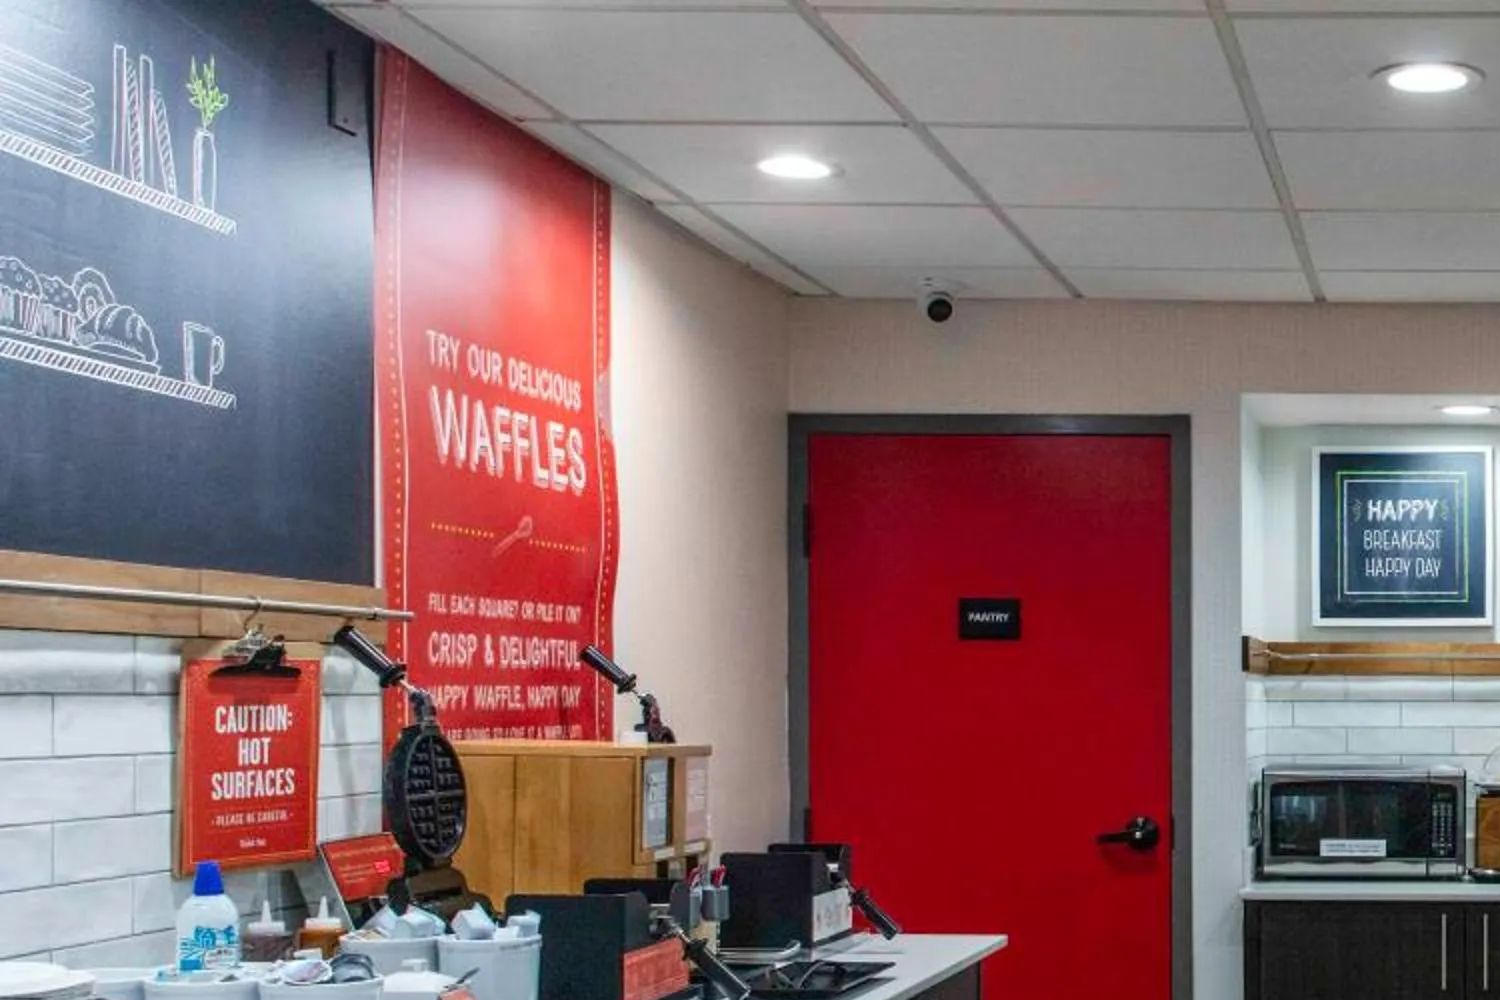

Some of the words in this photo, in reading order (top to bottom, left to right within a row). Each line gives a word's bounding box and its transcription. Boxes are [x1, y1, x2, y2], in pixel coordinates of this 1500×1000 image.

[426, 329, 461, 373] TRY
[467, 344, 502, 385] OUR
[507, 357, 582, 413] DELICIOUS
[429, 384, 587, 497] WAFFLES
[1367, 499, 1438, 522] HAPPY
[1363, 530, 1442, 551] BREAKFAST
[1365, 557, 1410, 577] HAPPY
[1415, 557, 1441, 578] DAY
[429, 631, 478, 668] CRISP
[484, 633, 495, 668] &
[500, 635, 581, 671] DELIGHTFUL
[528, 685, 558, 710] HAPPY
[561, 686, 581, 708] DAY
[215, 704, 293, 733] CAUTION:
[238, 737, 271, 766] HOT
[211, 768, 295, 801] SURFACES
